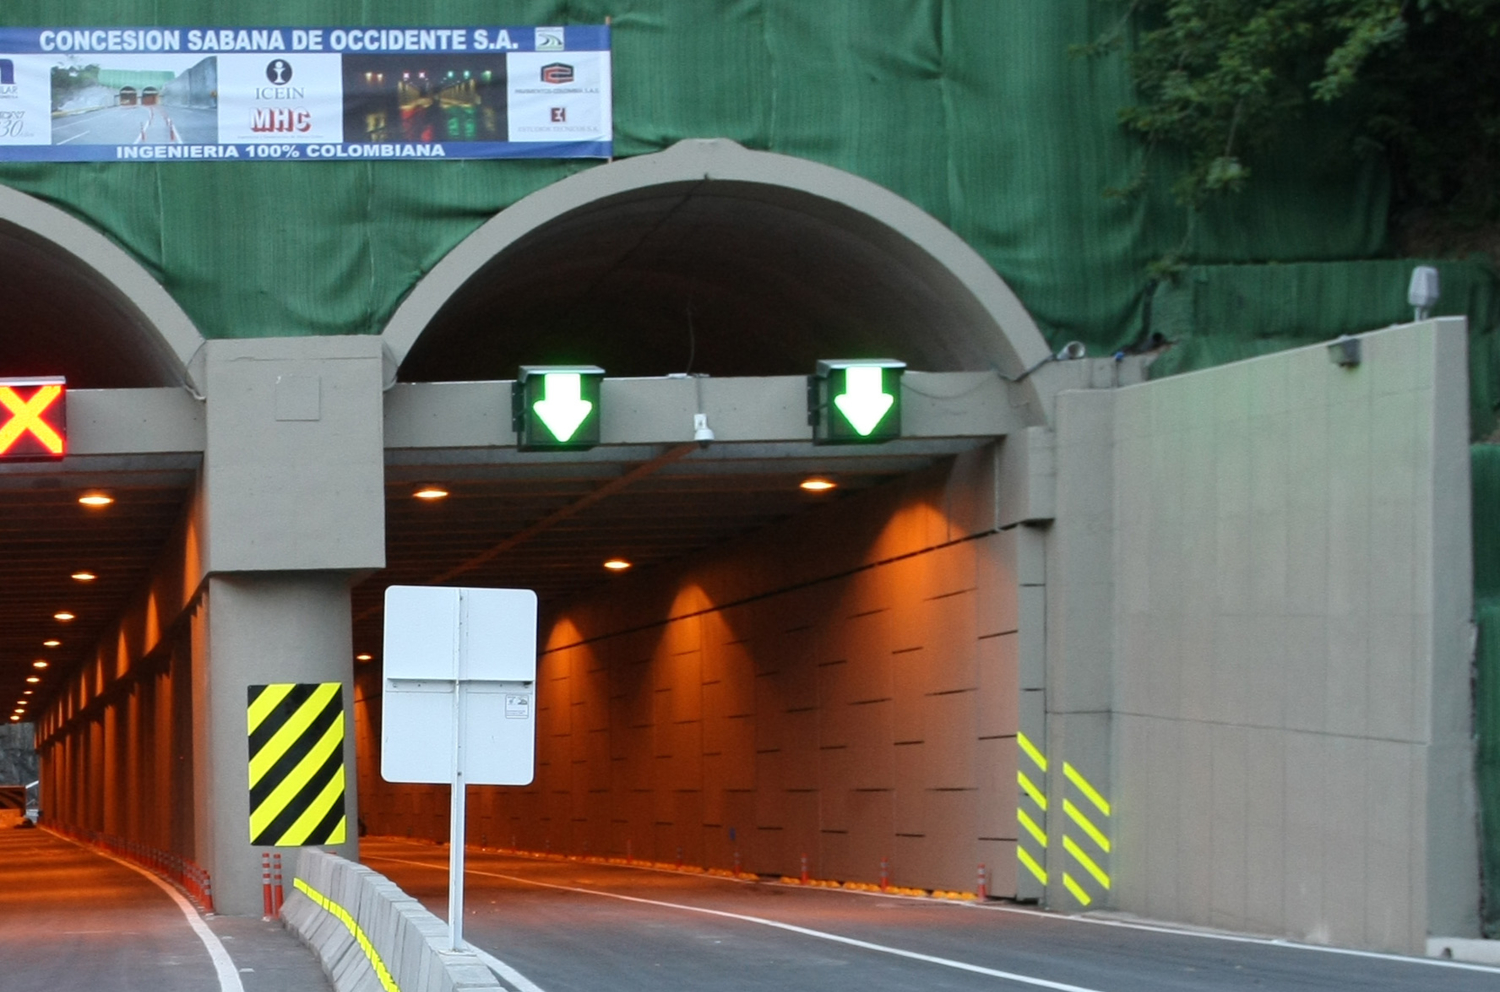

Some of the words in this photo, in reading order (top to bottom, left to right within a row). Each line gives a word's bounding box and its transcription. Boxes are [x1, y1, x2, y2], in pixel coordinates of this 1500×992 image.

[39, 30, 180, 51] CONCESION
[187, 30, 285, 50] SABANA
[292, 30, 323, 50] DE
[330, 29, 466, 50] OCCIDENTE
[473, 29, 519, 50] S.A.
[255, 87, 305, 100] ICEIN
[117, 146, 239, 159] INGENIERIA
[245, 145, 300, 158] 100%
[306, 144, 446, 157] COLOMBIANA
